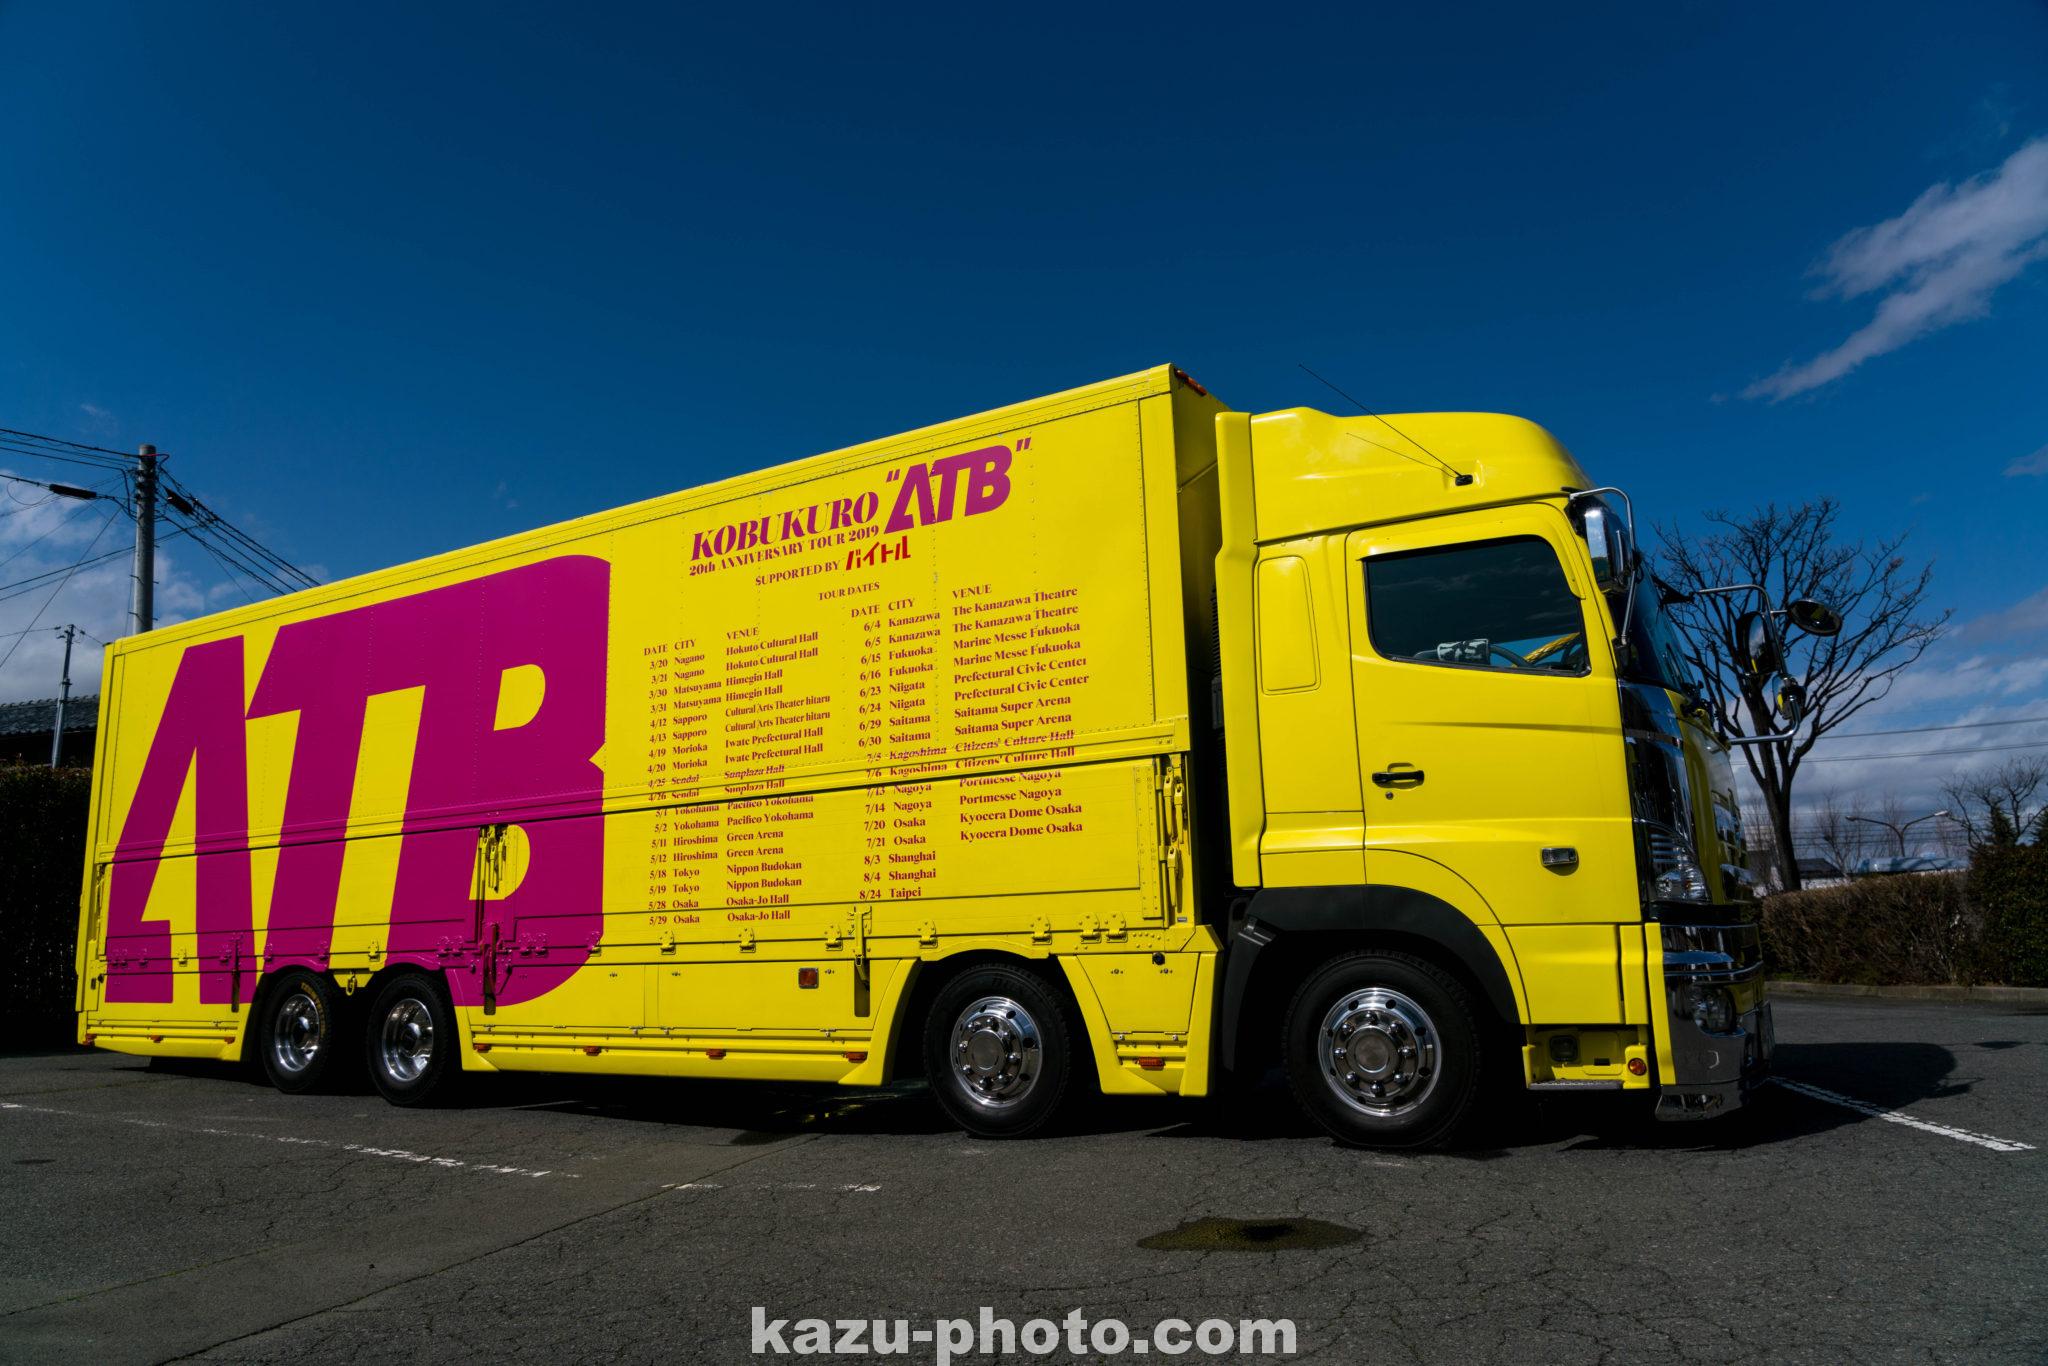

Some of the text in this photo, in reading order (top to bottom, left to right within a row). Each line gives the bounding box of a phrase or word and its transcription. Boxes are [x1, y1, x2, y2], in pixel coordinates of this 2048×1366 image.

[690, 491, 879, 561] KOBUKURO
[689, 525, 880, 577] 20th ANNIVERSARY TOUR 2019
[846, 535, 911, 570] バイトル
[755, 560, 840, 586] SUPPORTED BY
[819, 581, 880, 600] TOUR DATES
[851, 584, 992, 619] DATE CITY VENUE
[863, 588, 1078, 633] 6/4 Kanazawa The Kanazawa Theatre
[643, 627, 760, 656] DATE CITY VENUE
[864, 606, 1079, 649] 6/5 Kanazawa The Kanazawa Theatre
[650, 631, 819, 670] 3/20 Nagano Hokuto Cultural Hall
[860, 622, 1081, 666] 6/15 Fukuoka Marine Messe Fukuoka
[651, 647, 819, 685] 3/21 Nagano Hokuto Cultural Hall
[859, 640, 1081, 682] 6/16 Fukuoka Marine Messe Fukuoka
[649, 668, 783, 699] 3/30 Matsuyama Himegin Hall
[858, 675, 1090, 716] 6/24 Niigata Prefectural Civic Center
[859, 685, 882, 699] 6/23
[889, 681, 926, 694] Niigata
[954, 666, 1015, 685] Prefectural
[1016, 662, 1047, 675] Civic
[650, 684, 783, 714] 3/31 Matsuyama Himegin Hall
[650, 718, 667, 730] 4/12
[672, 714, 708, 726] Sapporo
[725, 706, 756, 718] Cultural
[758, 703, 774, 712] Arts
[775, 699, 805, 710] Theater
[859, 696, 1072, 732] 6/29 Saitama Saitama Super Arena
[648, 726, 824, 759] 4/19 Morioka Iwate Prefectural Hall
[650, 733, 667, 744] 4/13
[672, 729, 708, 742] Sapporo
[725, 720, 756, 733] Cultural
[758, 719, 774, 728] Arts
[775, 715, 805, 726] Theater
[858, 714, 1072, 749] 6/30 Saitama Saitama Super Arena
[647, 742, 824, 775] 4/20 Morioka Iwate Prefectural Hall
[104, 554, 611, 1007] ATB
[865, 788, 1062, 814] 7/14 Nagoya Portmesse Nagoya
[655, 811, 814, 834] 5/2 Yokohama Pacifico Yokohama
[864, 803, 1083, 832] 7/20 Osaka Kyocera Dome Osaka
[651, 830, 784, 850] 5/11 Hiroshima Green Arena
[867, 821, 1083, 849] 7/21 Osaka Kyocera Dome Osaka
[650, 861, 802, 881] 5/18 Tokyo Nippon Budokan
[651, 847, 784, 864] 5/12 Hiroshima Green Arena
[863, 851, 936, 868] 8/3 Shanghai
[649, 878, 802, 896] 5/19 Tokyo Nippon Budokan
[863, 869, 937, 884] 8/4 Shanghai
[648, 894, 790, 911] 5/28 Osaka Osaka-Jo Hall
[859, 887, 922, 901] 8/24 Taipei
[649, 909, 791, 927] 5/29 Osaka Osaka-Jo Hall
